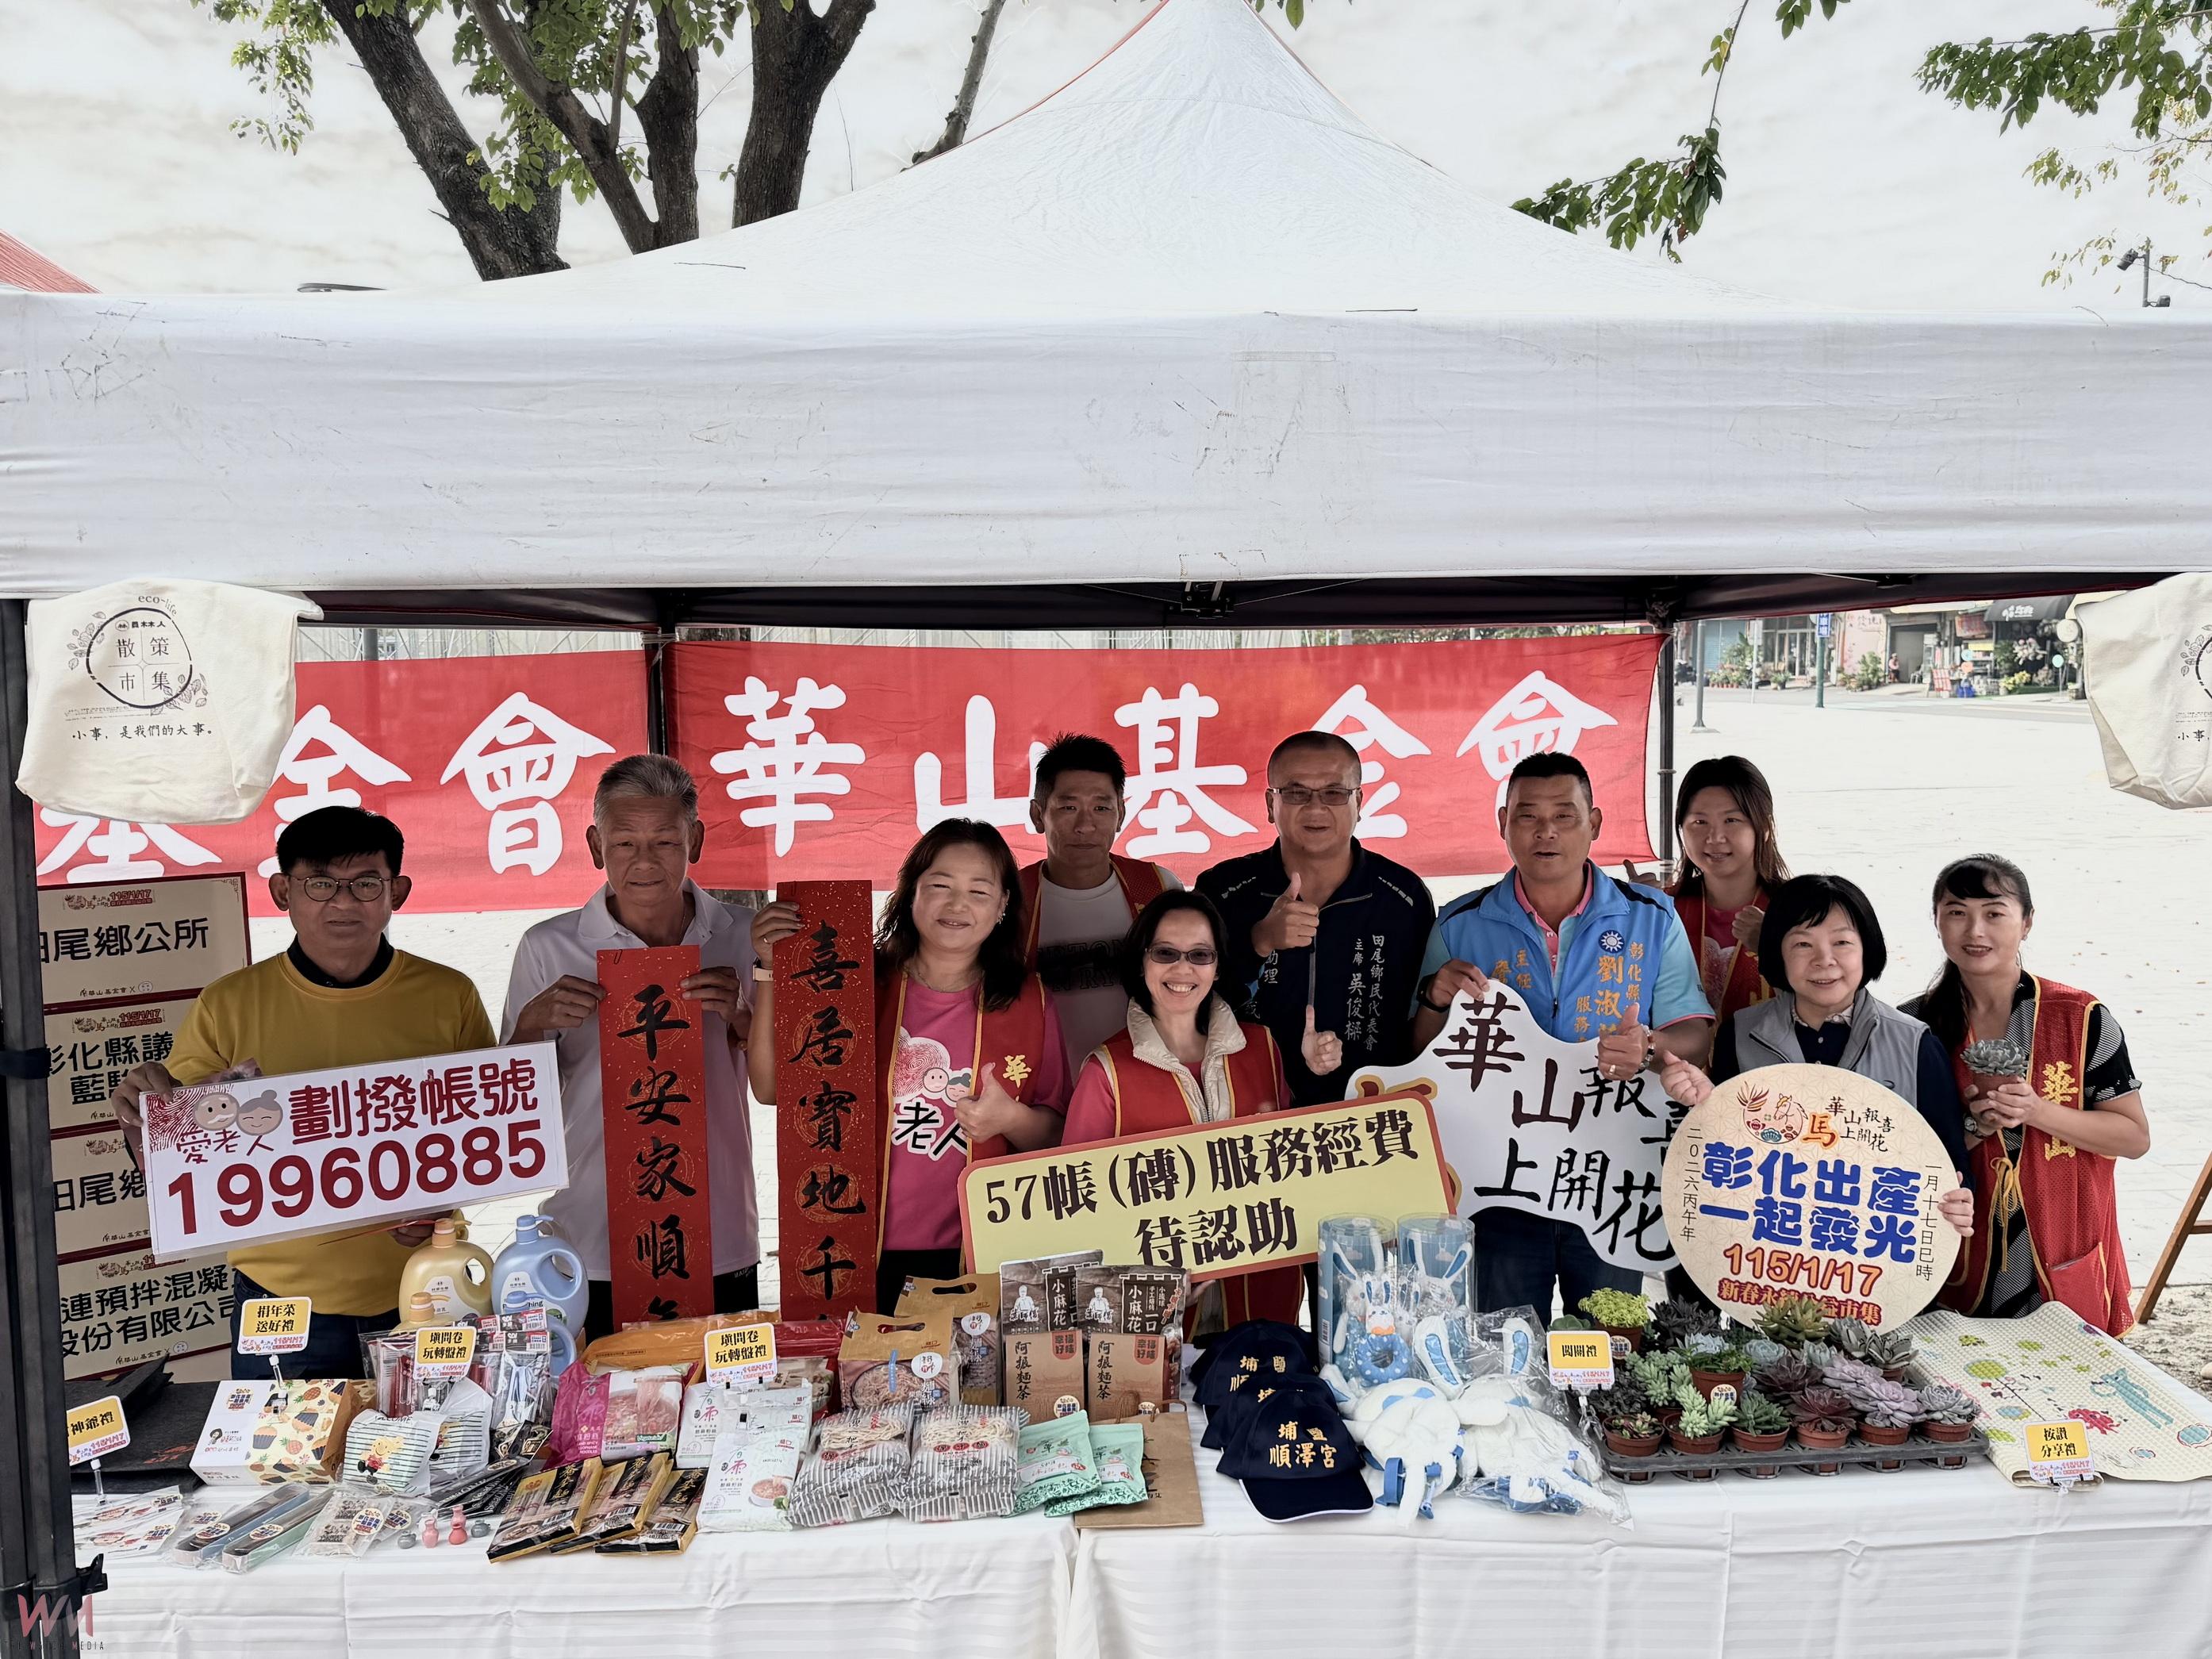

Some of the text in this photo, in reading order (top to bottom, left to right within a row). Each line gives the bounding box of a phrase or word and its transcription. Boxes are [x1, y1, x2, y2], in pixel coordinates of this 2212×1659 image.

[138, 595, 177, 616] eco-life
[117, 637, 169, 658] 散策
[119, 671, 171, 692] 市集
[1353, 938, 1364, 966] 主席
[1364, 935, 1385, 1051] 田尾鄉民代表會
[1626, 942, 1644, 1012] 彰化縣
[1574, 995, 1593, 1042] 服務
[288, 1058, 538, 1146] 劃撥帳號
[1003, 1054, 1031, 1103] 華
[788, 920, 866, 1320] 喜居寶地千
[1802, 1113, 1838, 1149] 馬
[1825, 1096, 1895, 1133] 華山報喜
[176, 1128, 275, 1165] 愛老人
[1839, 1126, 1888, 1152] 上開花
[168, 1119, 547, 1235] 19960885
[1702, 1141, 1922, 1217] 彰化出產
[1134, 1197, 1298, 1269] 待認助
[1699, 1196, 1918, 1264] 一起發光
[60, 1264, 236, 1324] 連預拌混凝
[1723, 1242, 1883, 1298] 115/1/17
[255, 1319, 295, 1333] 送好禮
[257, 1304, 296, 1318] 捐年菜
[1051, 1278, 1067, 1327] 小麻花
[1127, 1285, 1143, 1333] 小麻花
[1718, 1277, 1883, 1327] 新春永益市集
[1015, 1341, 1032, 1400] 阿振麵茶
[1096, 1340, 1115, 1400] 阿振麵茶
[67, 1411, 115, 1437] 神爺禮
[1269, 1442, 1337, 1469] 順澤宮
[2041, 1442, 2078, 1458] 分享禮
